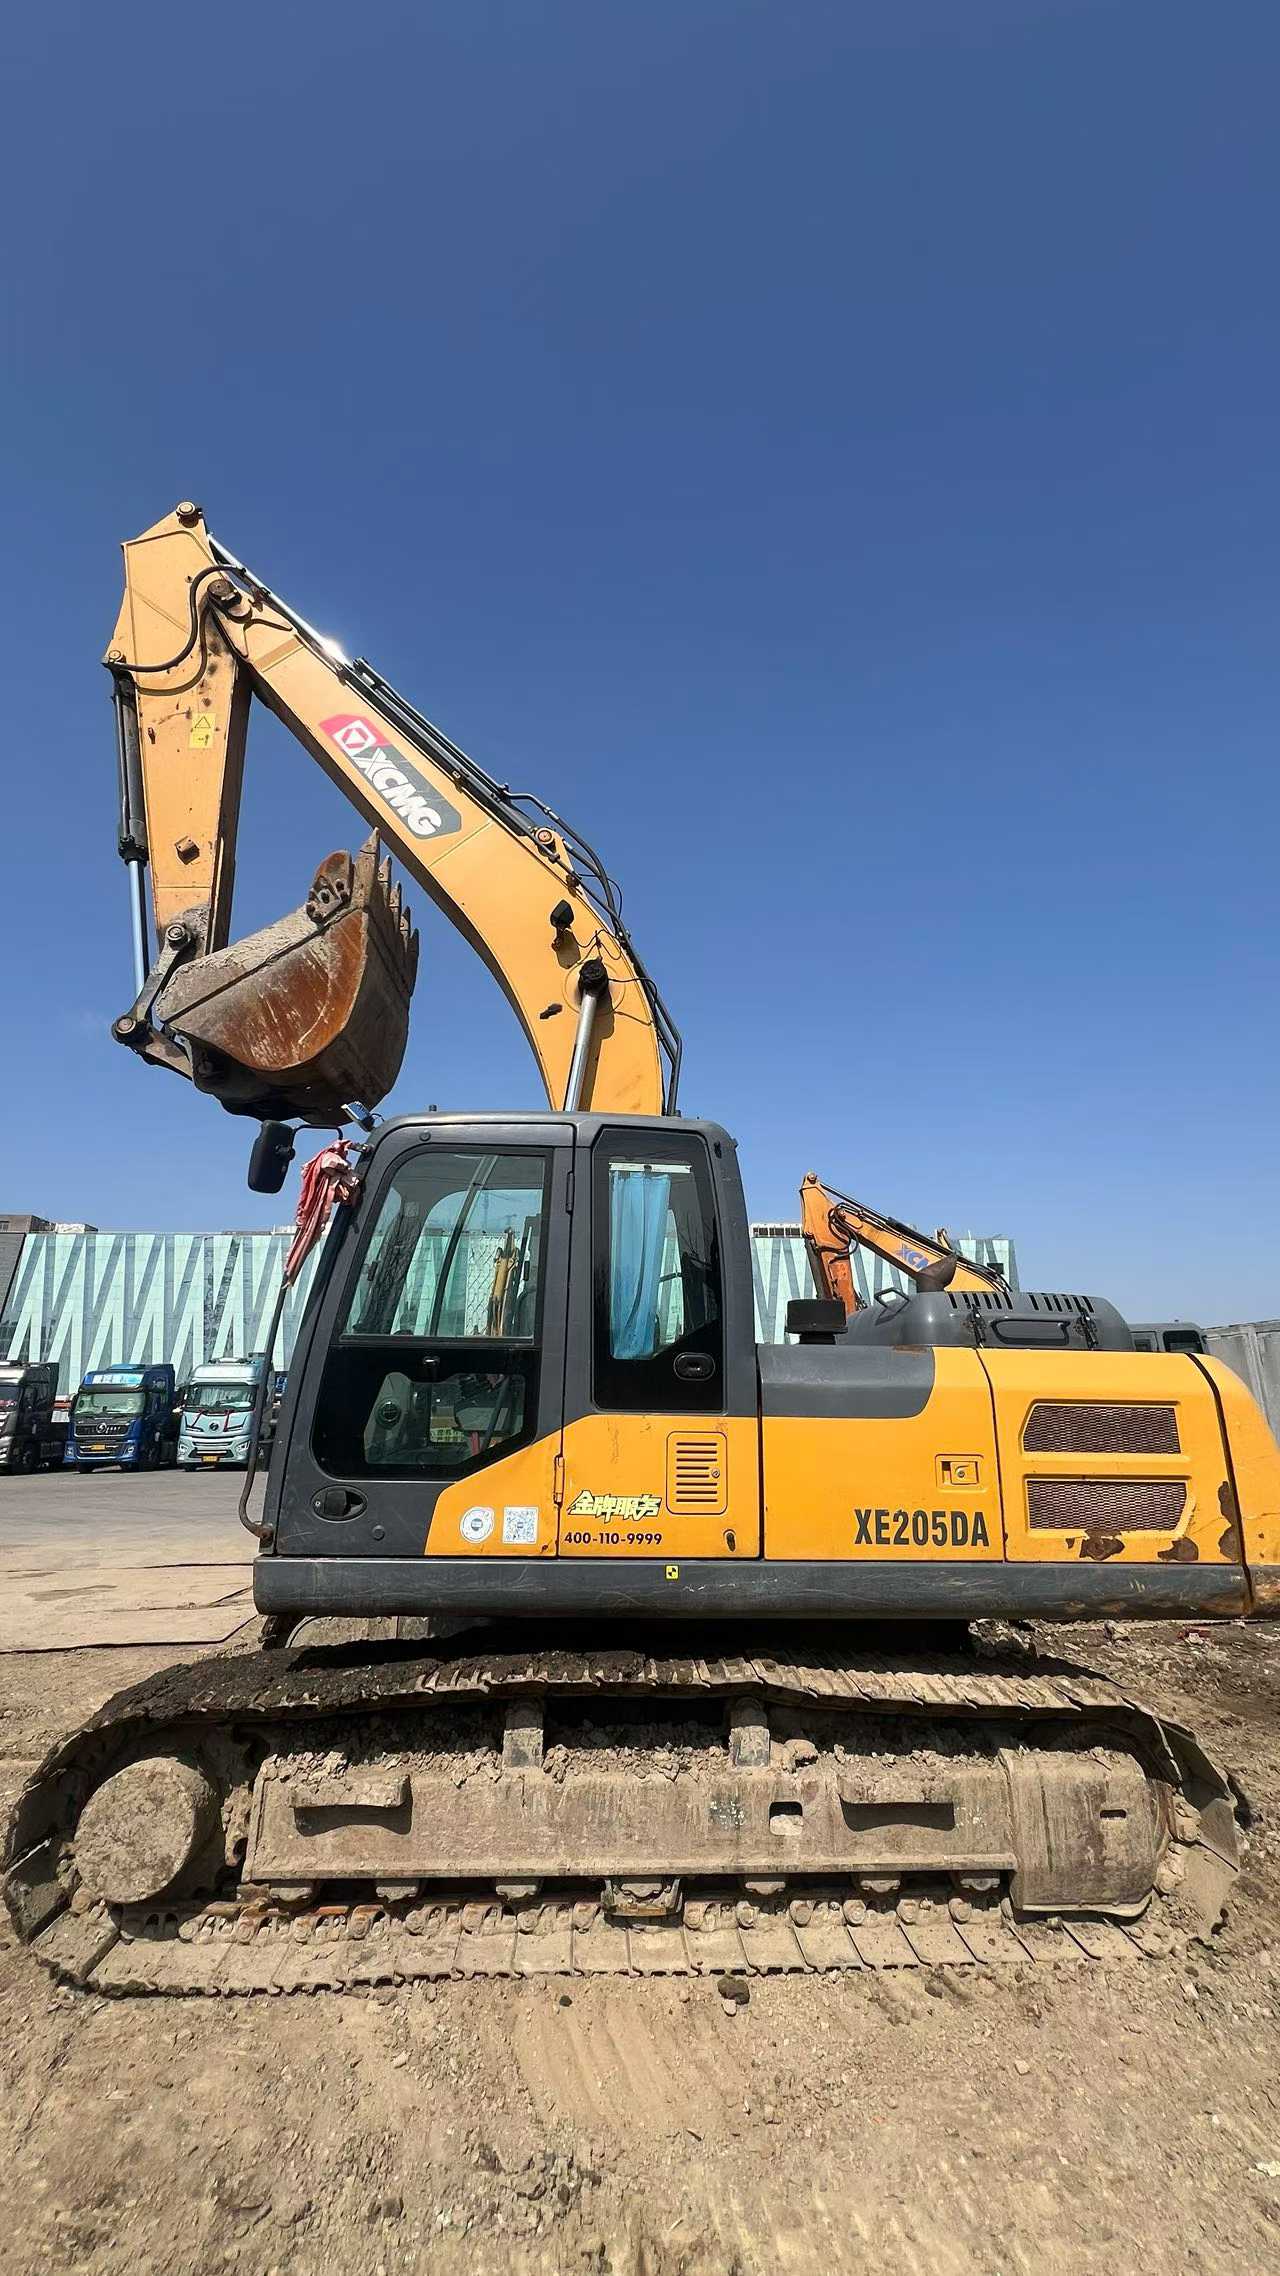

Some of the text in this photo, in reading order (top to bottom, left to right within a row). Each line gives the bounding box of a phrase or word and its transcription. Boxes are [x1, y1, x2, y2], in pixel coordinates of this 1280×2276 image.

[352, 748, 441, 835] XCMG
[566, 1489, 663, 1524] 金牌服务
[564, 1531, 662, 1545] 400-110-9999
[854, 1508, 990, 1547] XE205DA
